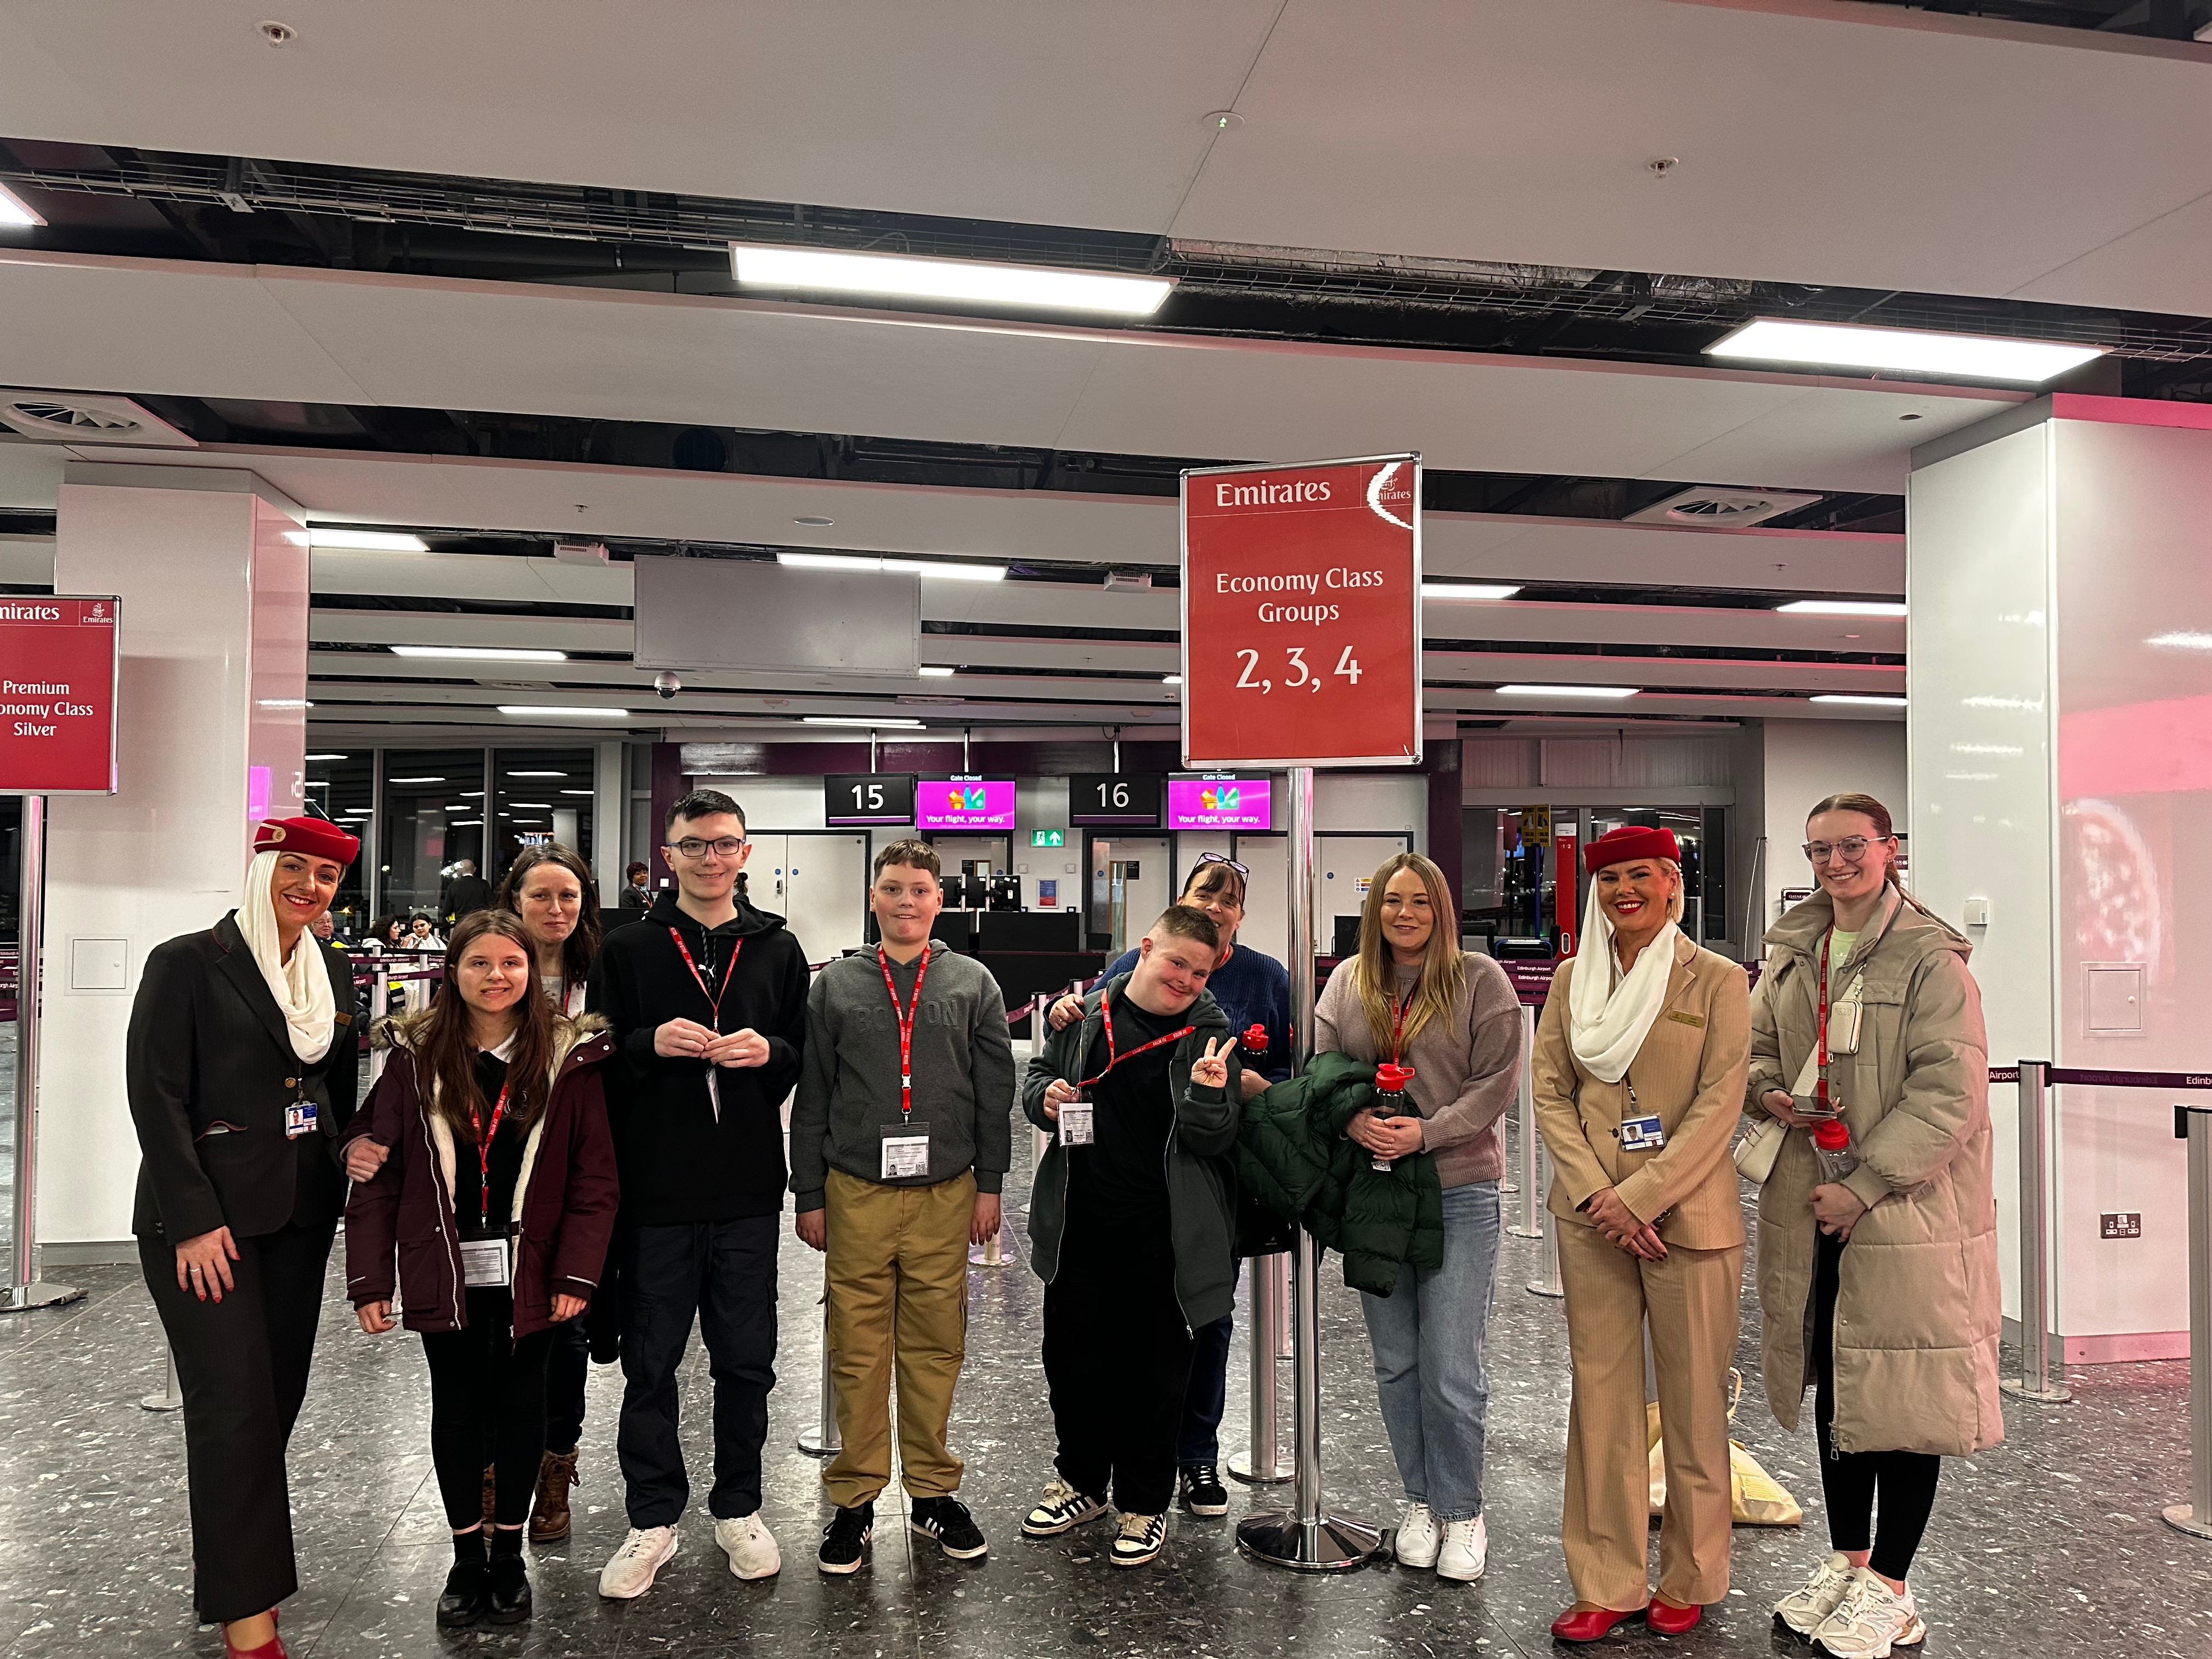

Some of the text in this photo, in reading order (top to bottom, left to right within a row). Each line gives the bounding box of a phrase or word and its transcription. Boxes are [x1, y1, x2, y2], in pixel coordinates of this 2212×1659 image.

[1216, 479, 1331, 507] Emirates
[1216, 568, 1384, 595] Economy Class
[0, 603, 60, 620] mirates
[1258, 602, 1339, 625] Groups
[1235, 645, 1362, 695] 2, 3, 4
[3, 680, 70, 695] Premium
[0, 702, 94, 719] onomy Class
[14, 722, 57, 736] Silver
[851, 784, 884, 810] 15
[1097, 783, 1130, 808] 16
[945, 815, 967, 824] flight,
[968, 816, 986, 824] your
[988, 816, 1005, 824] way.
[1198, 815, 1220, 824] flight,
[1222, 816, 1240, 824] your
[1242, 816, 1260, 824] way.
[1989, 1071, 2019, 1081] Airport
[2186, 1076, 2212, 1085] Edinb
